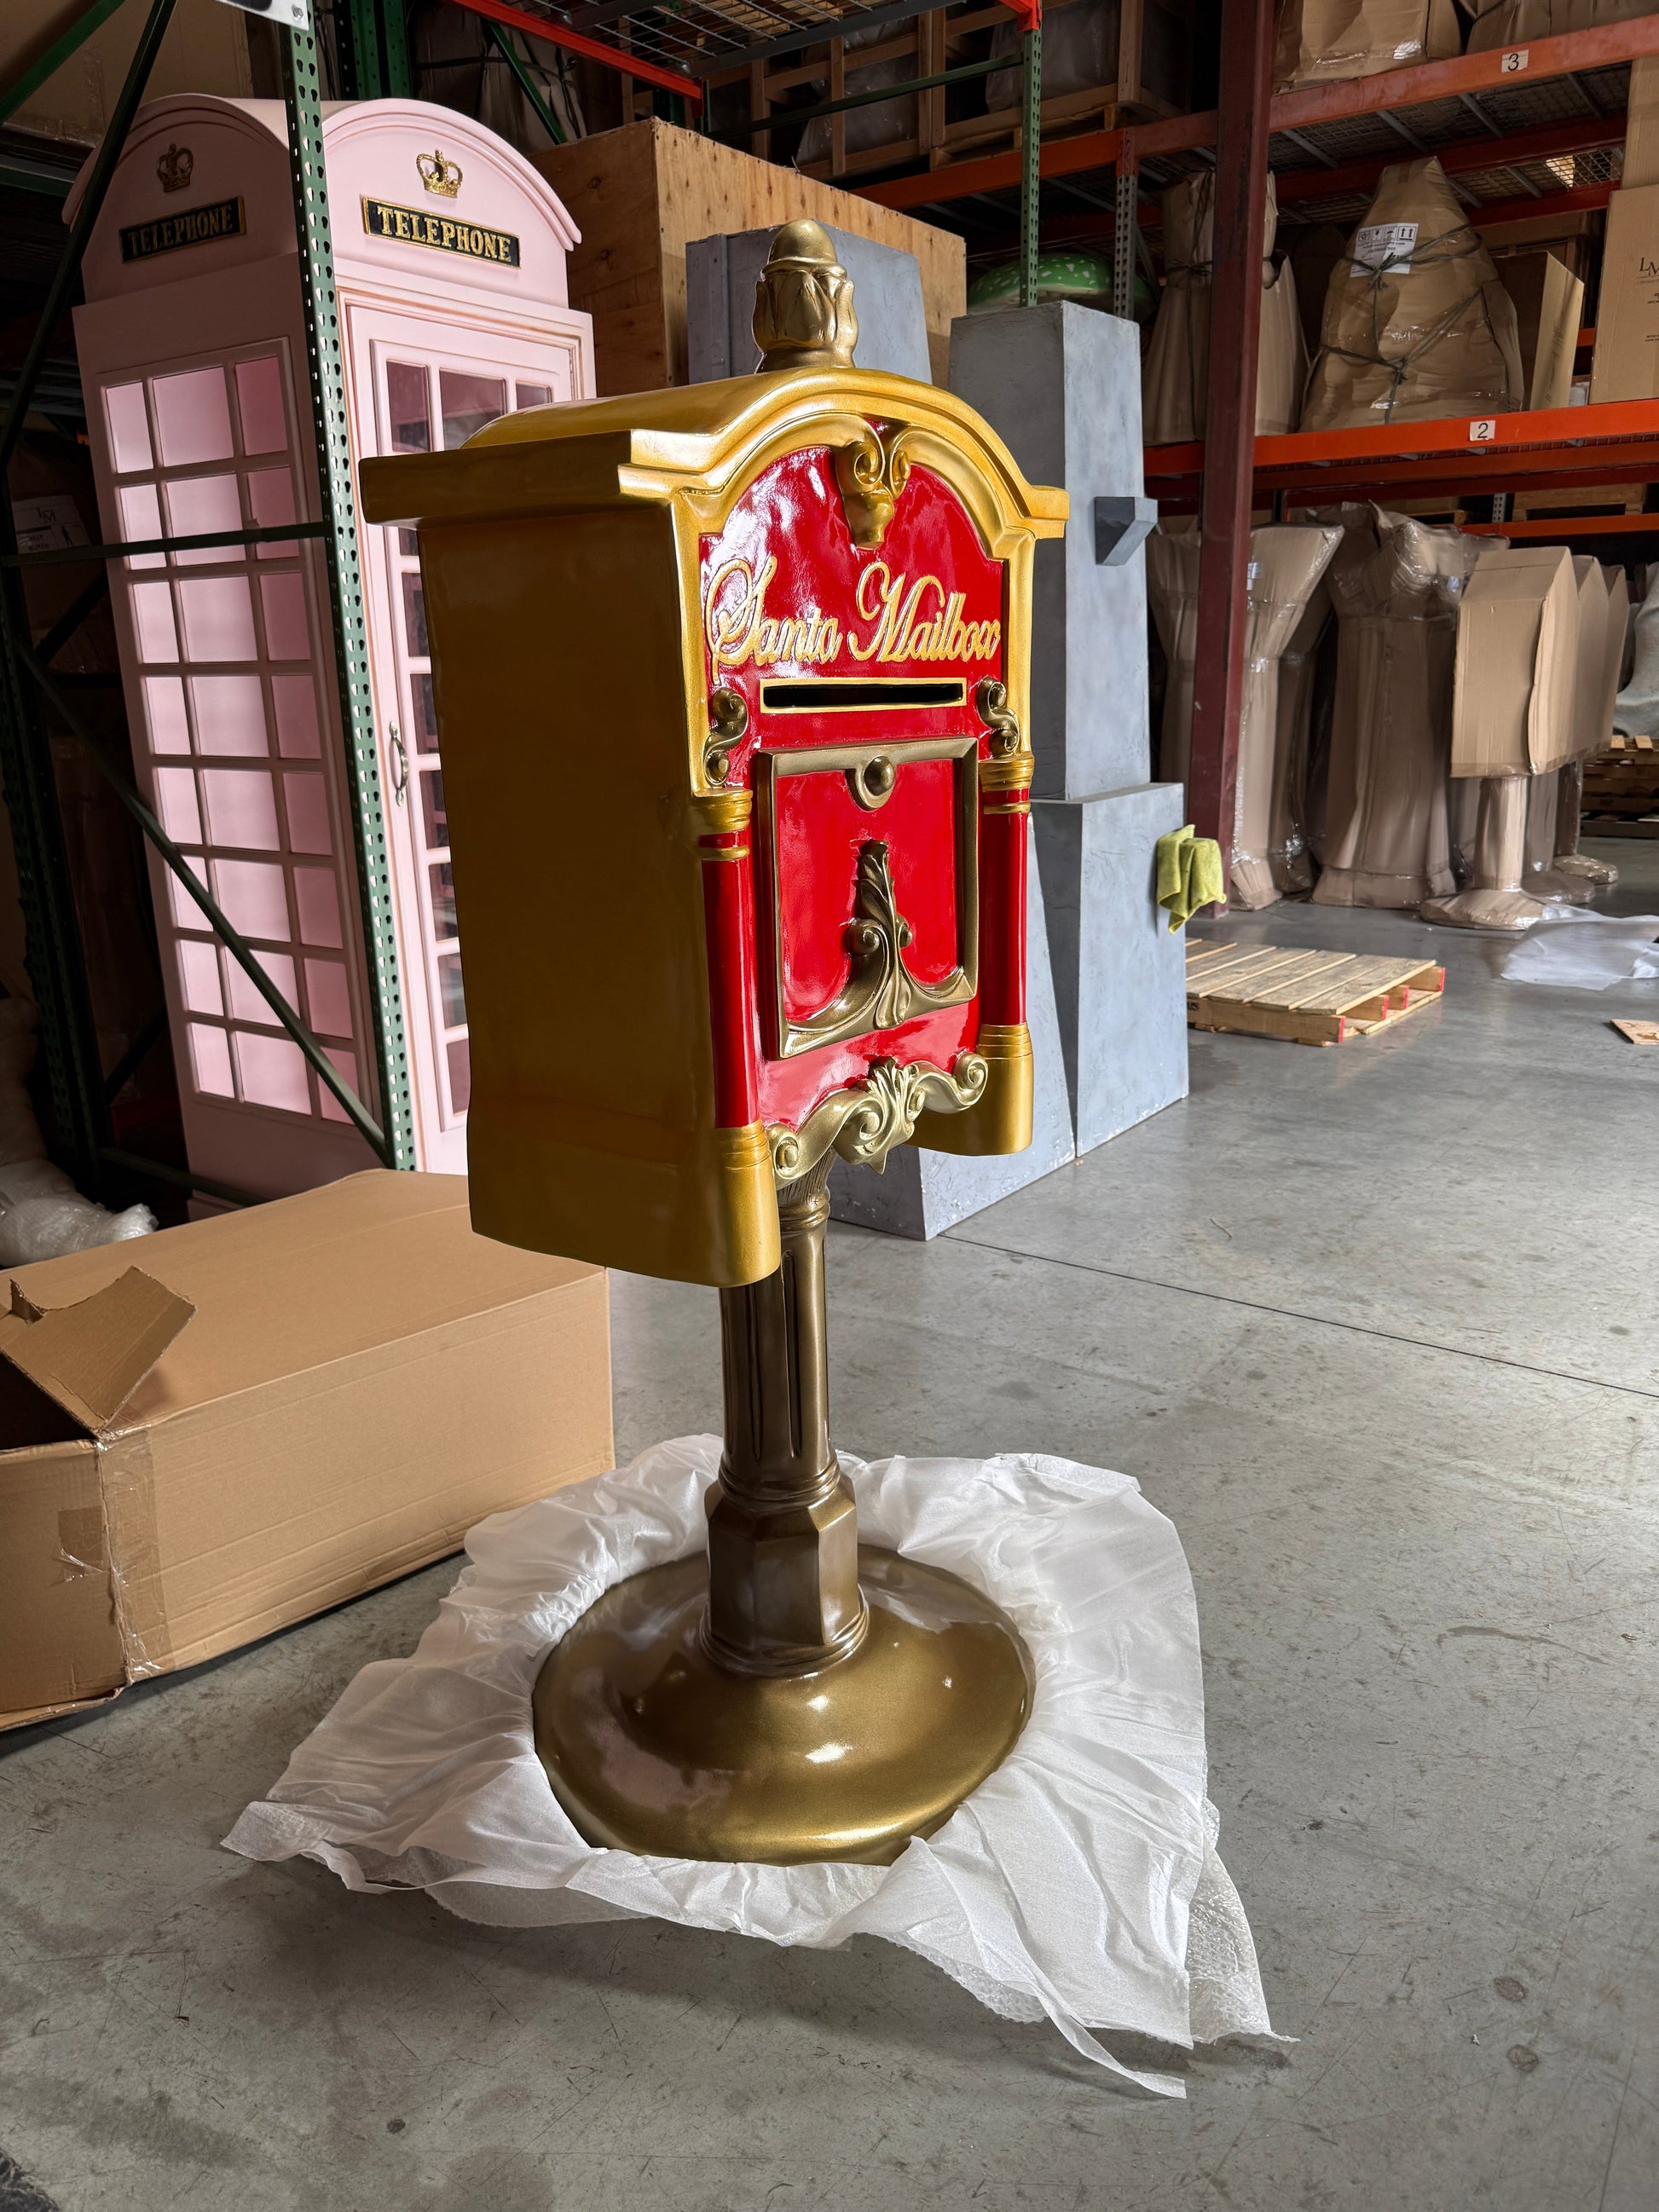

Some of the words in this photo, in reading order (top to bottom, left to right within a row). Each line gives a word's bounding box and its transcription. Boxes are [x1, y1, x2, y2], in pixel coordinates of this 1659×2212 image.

[1507, 53, 1519, 72] 3
[130, 205, 234, 257] TELEPHONE
[377, 206, 512, 263] TELEPHONE
[1477, 422, 1488, 439] 2
[706, 555, 843, 685] Santa
[847, 561, 1002, 663] Mailbox
